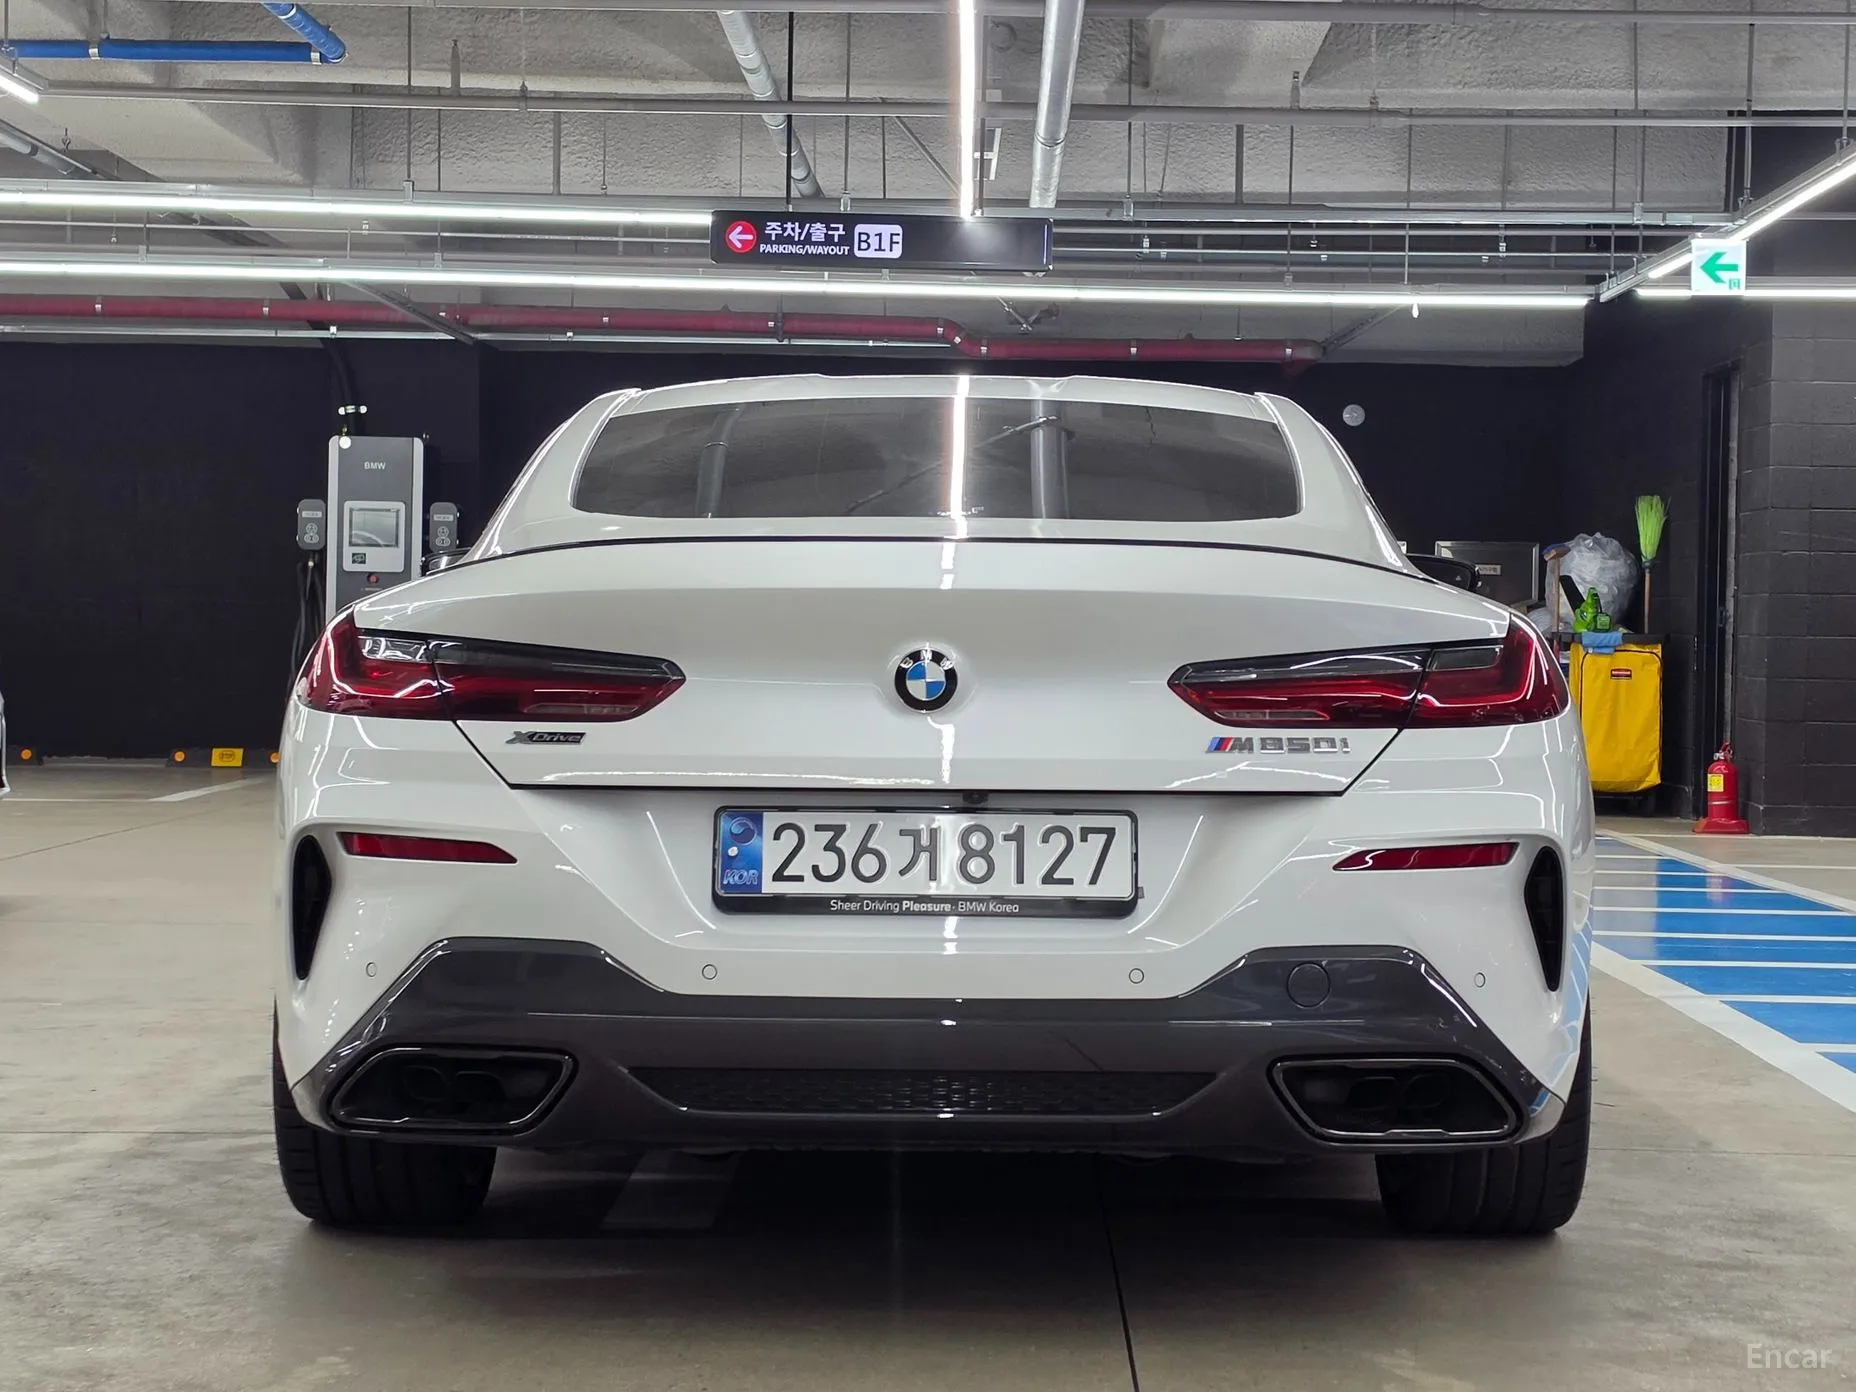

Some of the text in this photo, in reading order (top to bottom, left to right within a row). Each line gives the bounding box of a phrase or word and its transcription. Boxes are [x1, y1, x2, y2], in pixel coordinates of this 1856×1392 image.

[764, 222, 846, 242] 주차/출구
[760, 243, 850, 255] PARKING/WAYOUT
[857, 232, 900, 252] B1F
[723, 869, 759, 885] KOR
[830, 900, 1020, 913] Sheer Driving Pleasure BMW Korea
